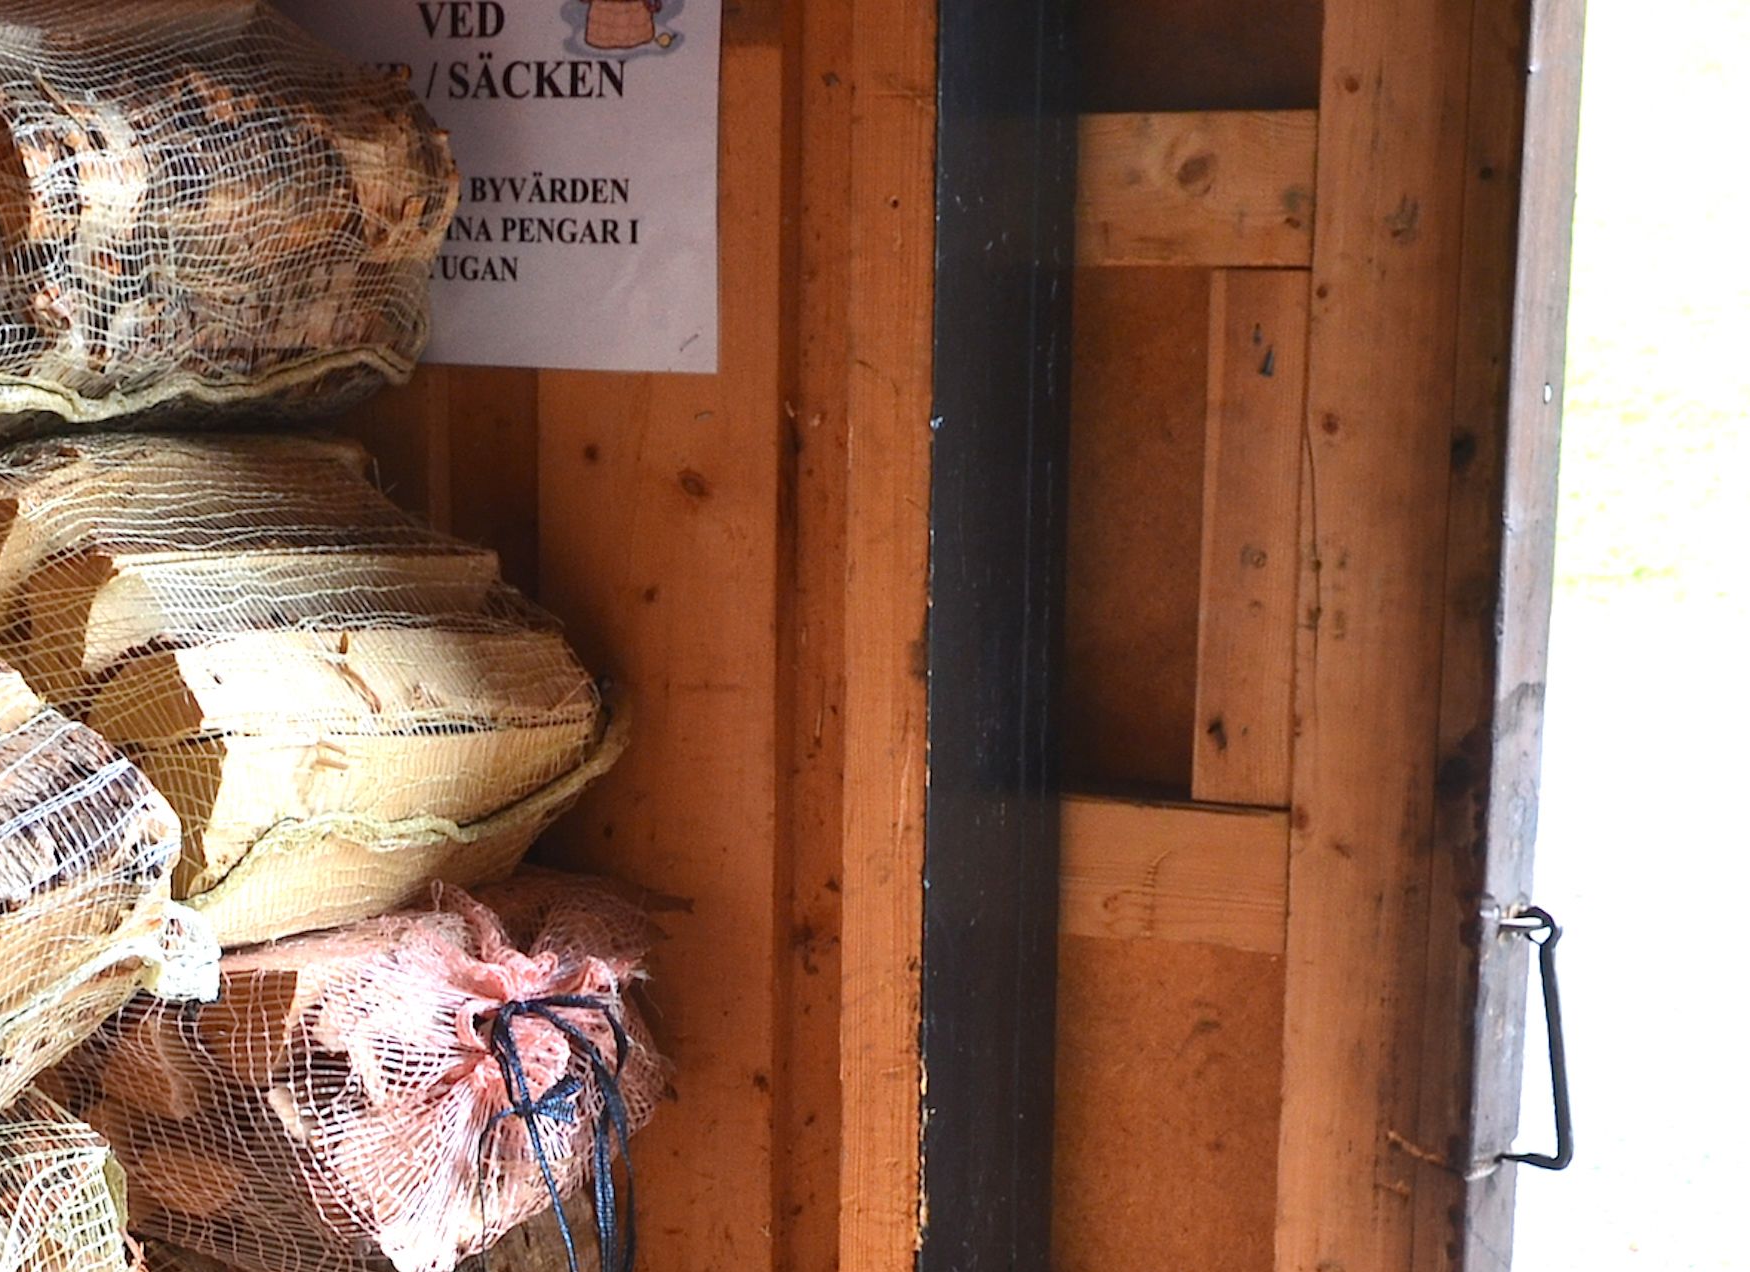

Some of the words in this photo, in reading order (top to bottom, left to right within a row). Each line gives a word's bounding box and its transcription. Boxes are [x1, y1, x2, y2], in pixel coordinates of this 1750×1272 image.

[418, 1, 505, 39] VED
[449, 52, 627, 99] SÄCKEN
[470, 172, 629, 204] BYVÄRDEN
[446, 216, 492, 241] INA
[501, 216, 620, 244] PENGAR
[629, 219, 639, 244] I
